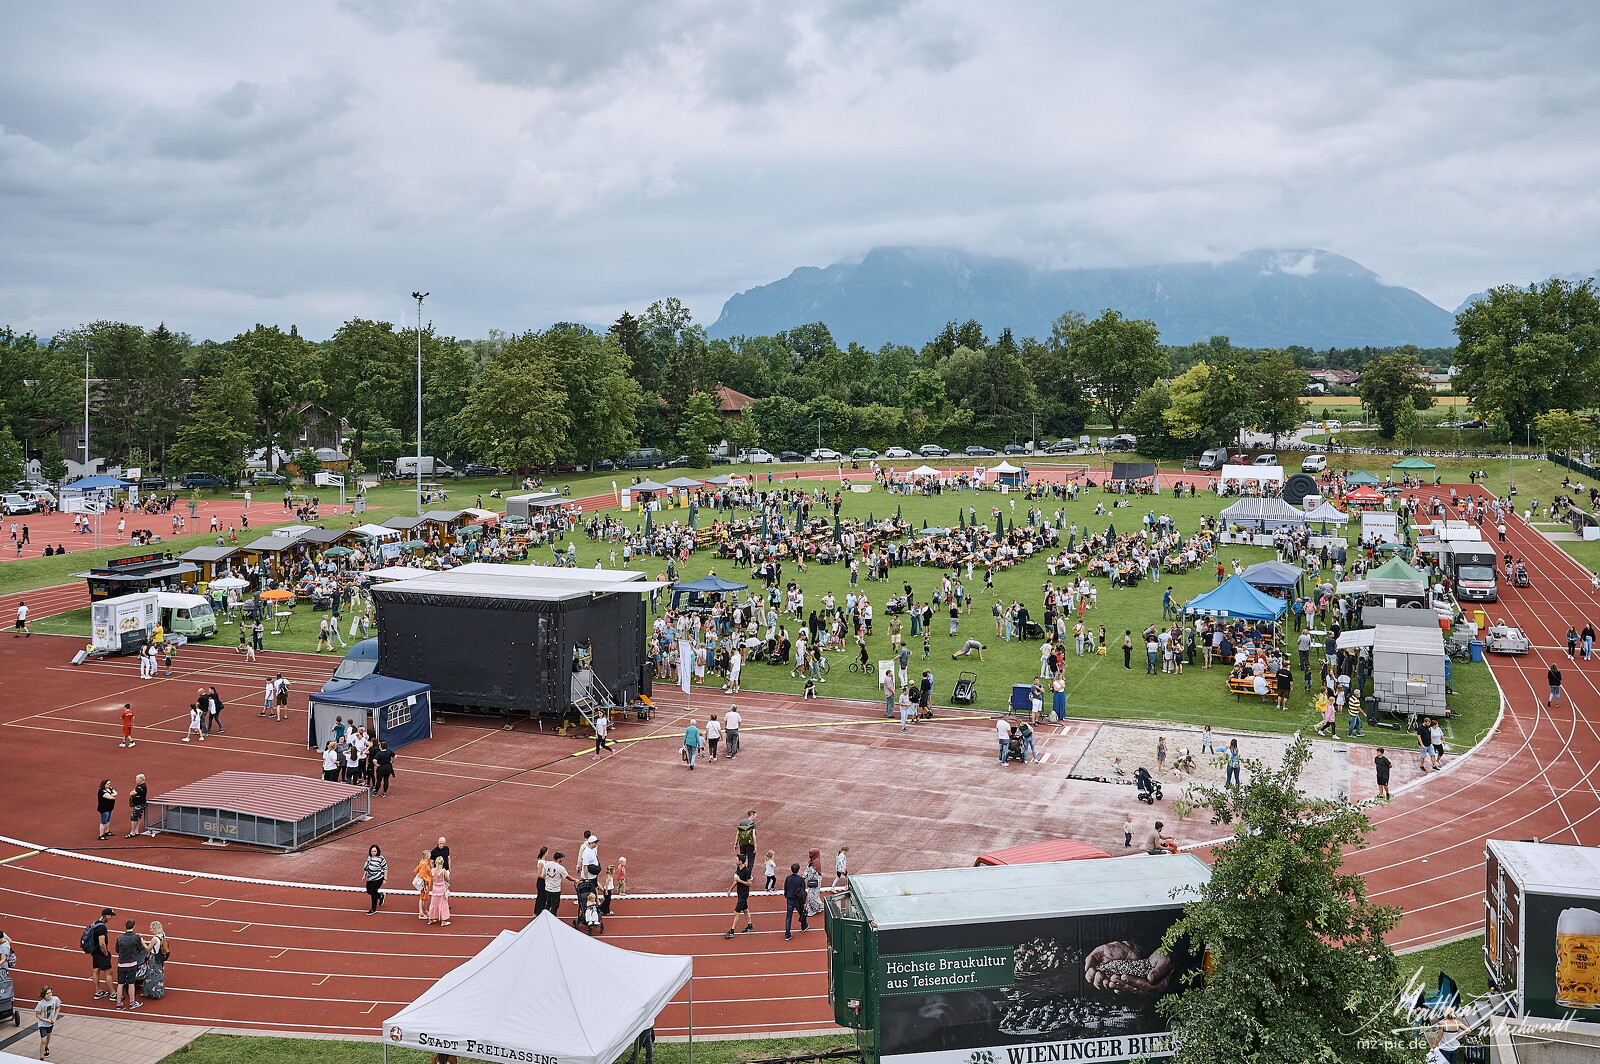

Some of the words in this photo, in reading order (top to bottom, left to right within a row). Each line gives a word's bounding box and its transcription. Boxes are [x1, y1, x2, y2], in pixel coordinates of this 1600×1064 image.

[203, 821, 238, 834] BENZ
[886, 962, 936, 974] Höchste
[939, 955, 1007, 970] Braukultur
[886, 979, 908, 989] aus
[911, 972, 978, 987] Teisendorf.
[1006, 1038, 1124, 1064] WIENINGER
